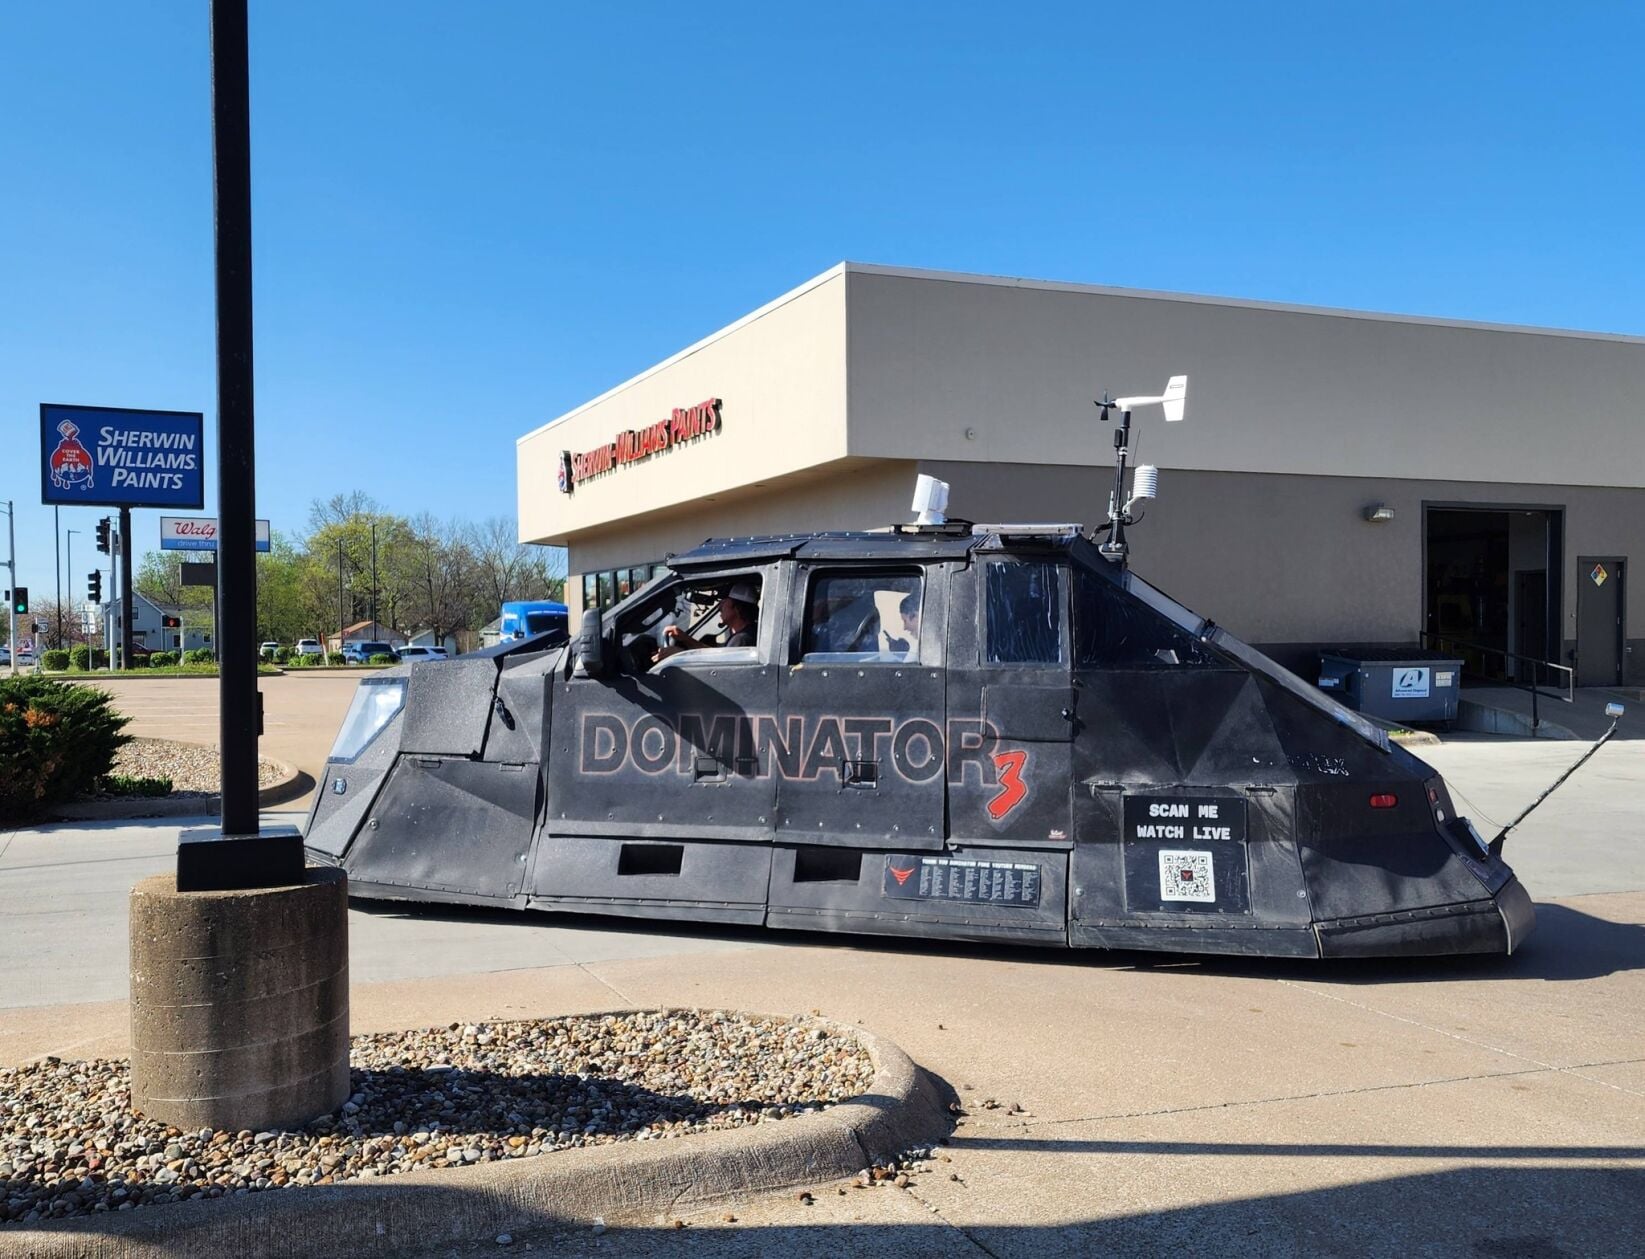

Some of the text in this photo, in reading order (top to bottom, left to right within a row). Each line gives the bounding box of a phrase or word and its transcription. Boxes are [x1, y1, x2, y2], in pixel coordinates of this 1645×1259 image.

[669, 397, 721, 446] PAINTS
[98, 426, 195, 450] SHERWIN
[97, 446, 196, 470] WILLIAMS
[111, 468, 183, 489] PAINTS
[579, 713, 1029, 821] DOMINATOR 3
[1149, 804, 1219, 818] SCAN ME
[1136, 825, 1231, 840] WATCH LIVE
